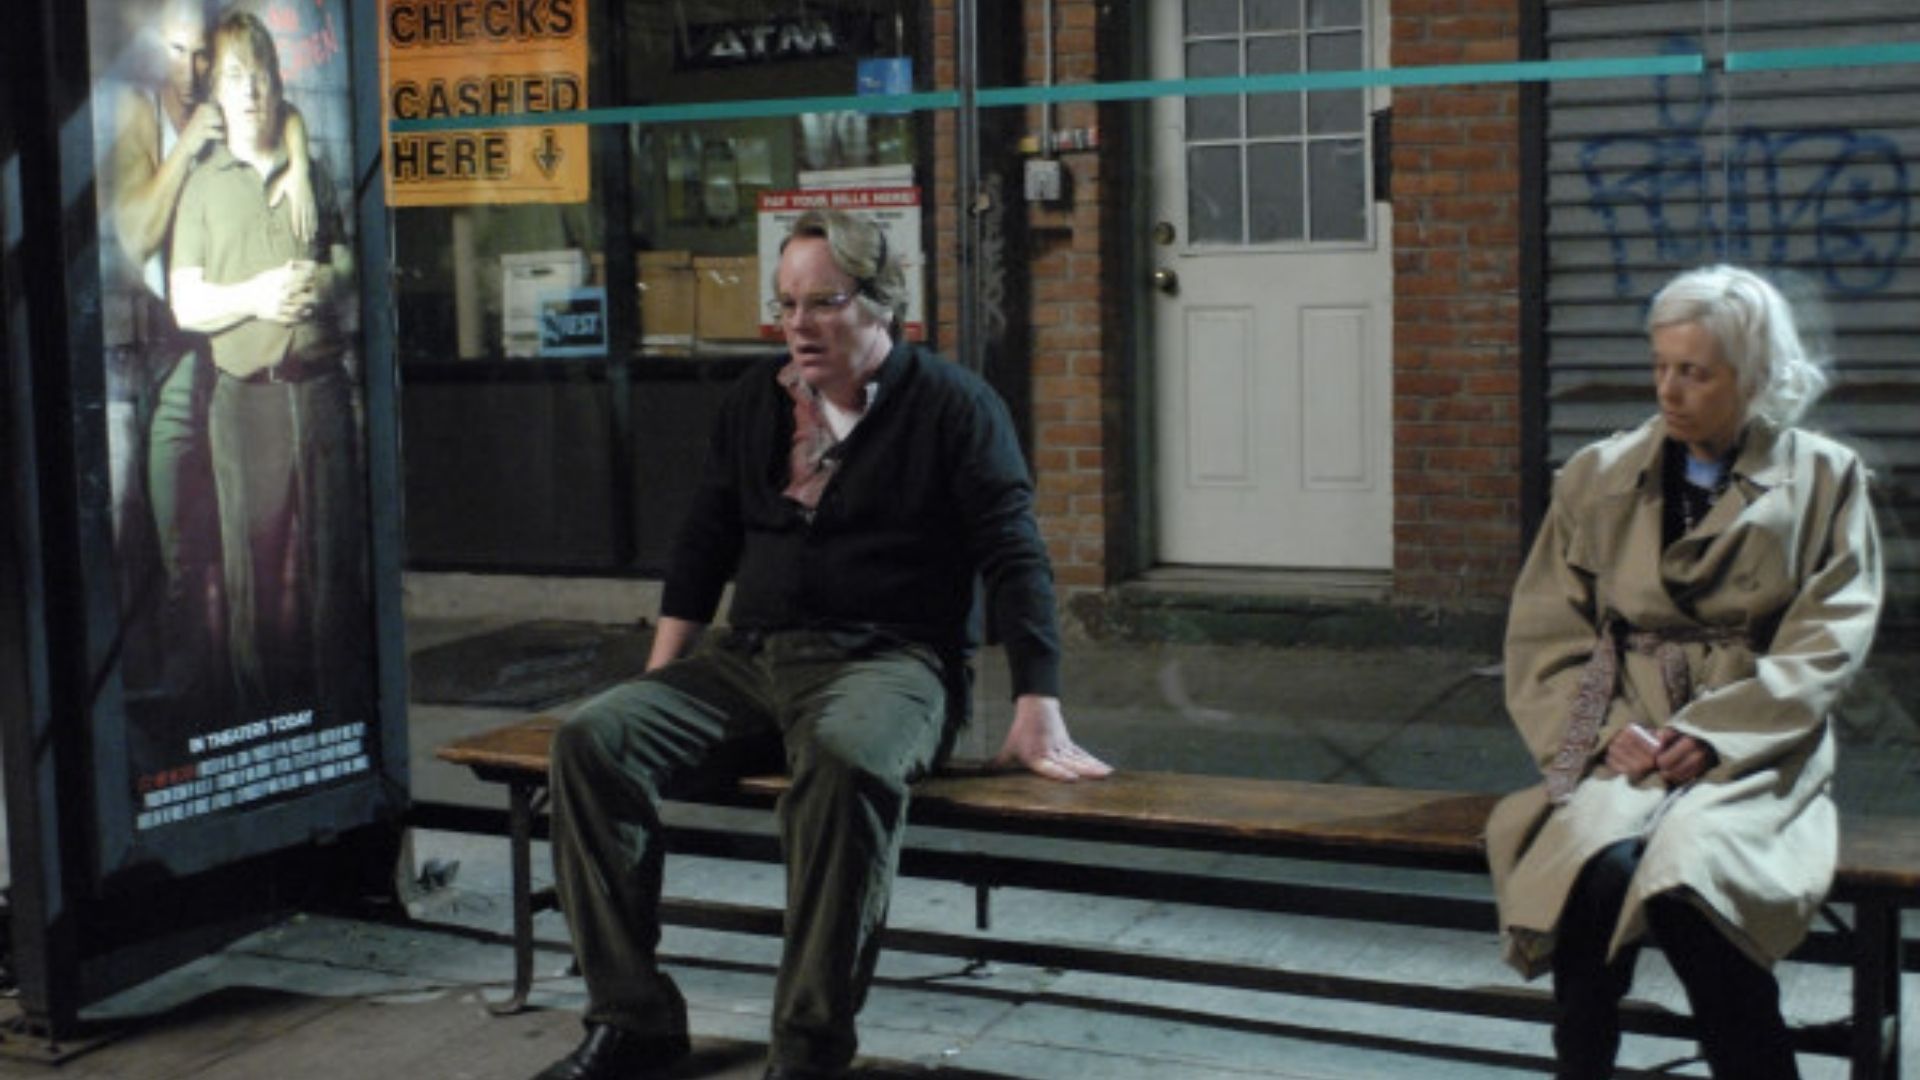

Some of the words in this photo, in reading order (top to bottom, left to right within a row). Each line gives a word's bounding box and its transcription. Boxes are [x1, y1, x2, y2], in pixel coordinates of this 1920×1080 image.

[389, 0, 575, 44] CHECKS
[711, 23, 836, 57] ATM
[391, 75, 580, 120] CASHED
[391, 135, 508, 179] HERE
